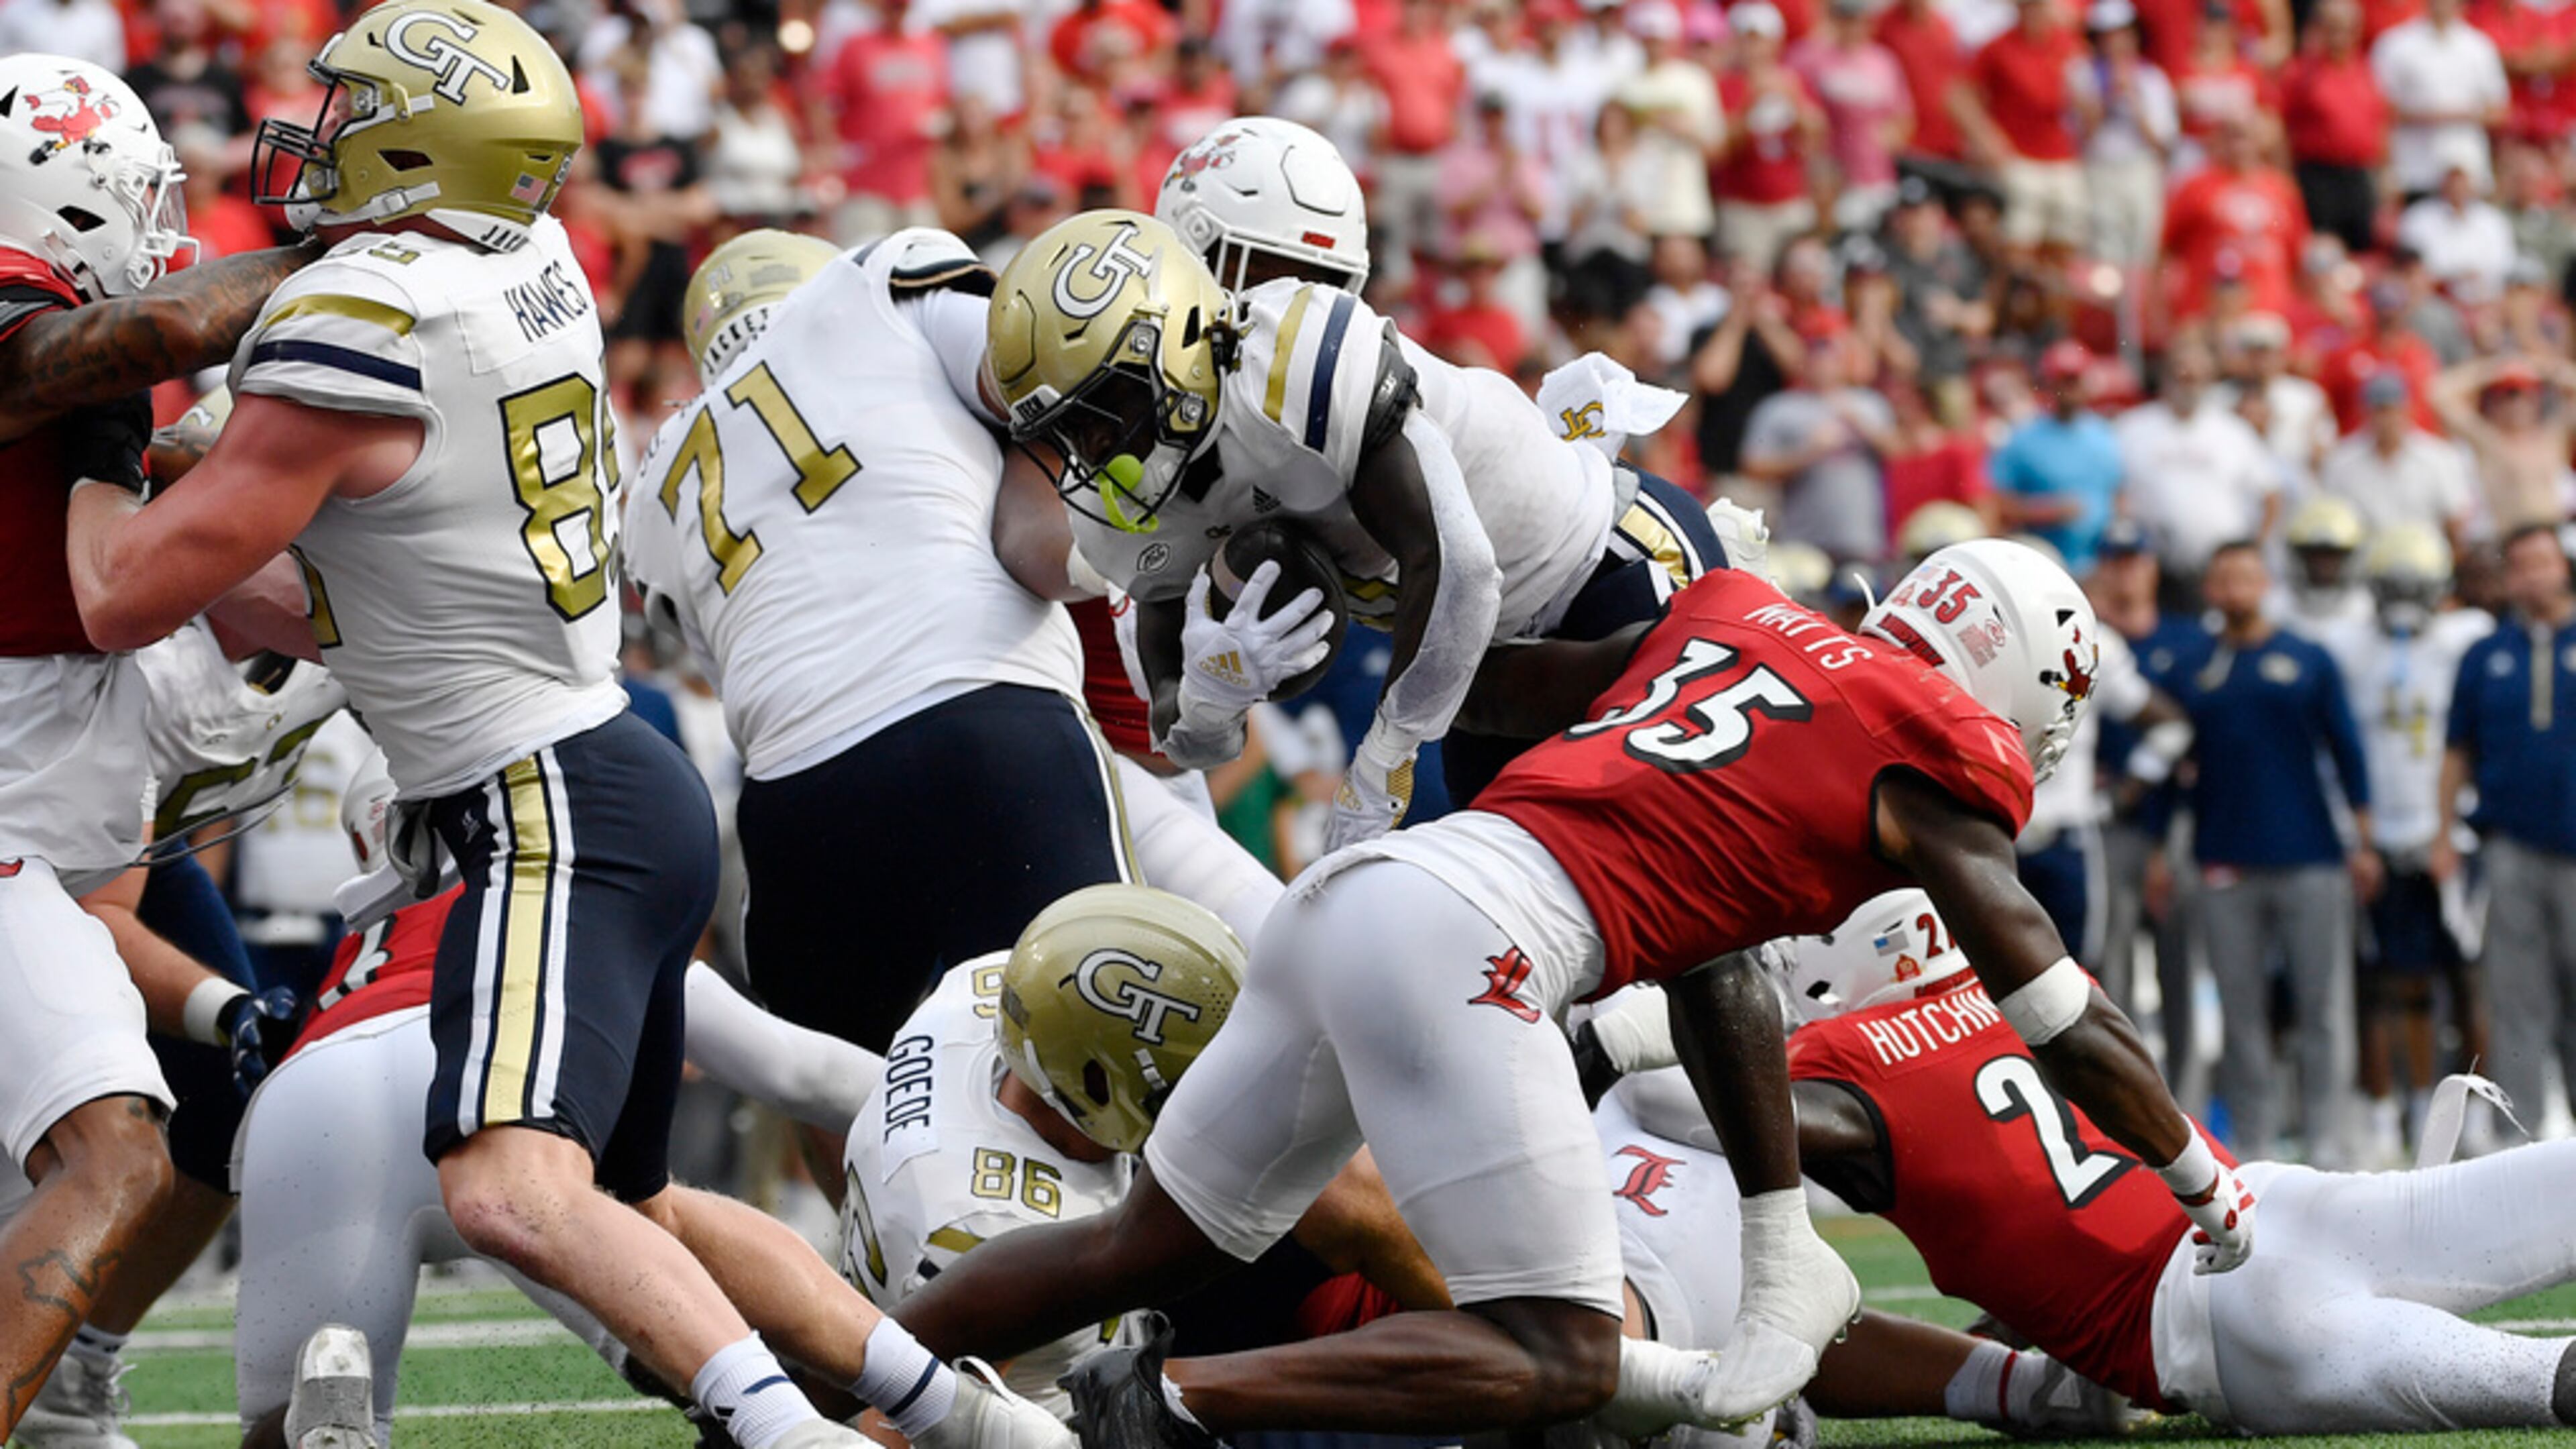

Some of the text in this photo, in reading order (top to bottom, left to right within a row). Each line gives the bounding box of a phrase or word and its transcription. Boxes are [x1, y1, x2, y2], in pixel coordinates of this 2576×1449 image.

[384, 10, 511, 105] GT
[503, 260, 588, 343] HAWES
[1052, 224, 1152, 320] GT
[659, 361, 863, 597] 71
[1916, 569, 1983, 625] 35
[1562, 636, 1814, 775] 35
[1074, 947, 1202, 1046] GT
[884, 1034, 934, 1145] GOEDE
[971, 1146, 1063, 1219] 86
